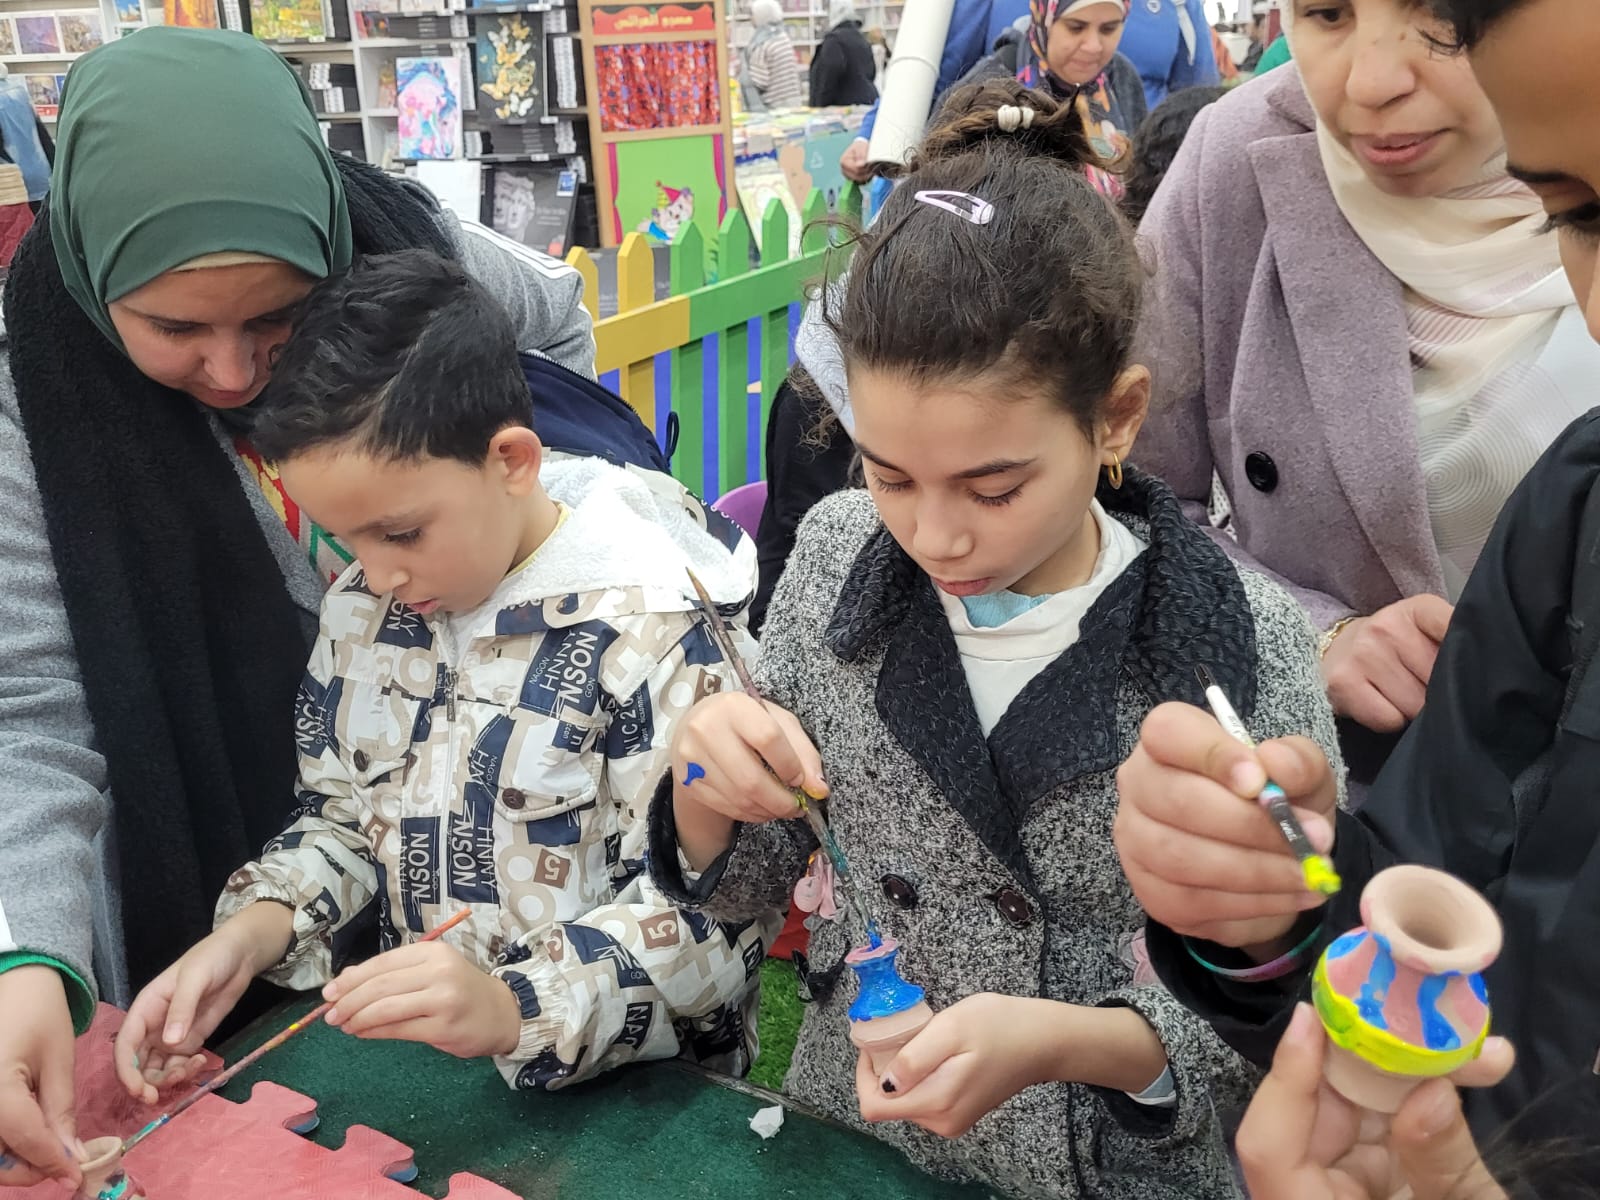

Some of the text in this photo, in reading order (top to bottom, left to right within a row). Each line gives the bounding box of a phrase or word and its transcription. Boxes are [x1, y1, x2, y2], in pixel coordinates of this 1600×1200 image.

[528, 656, 551, 685] NAGON
[539, 629, 576, 692] HNNY
[558, 630, 599, 704] NSON
[408, 832, 432, 899] NSON
[452, 818, 477, 888] NSON
[544, 854, 562, 881] 5
[647, 918, 677, 940] 5
